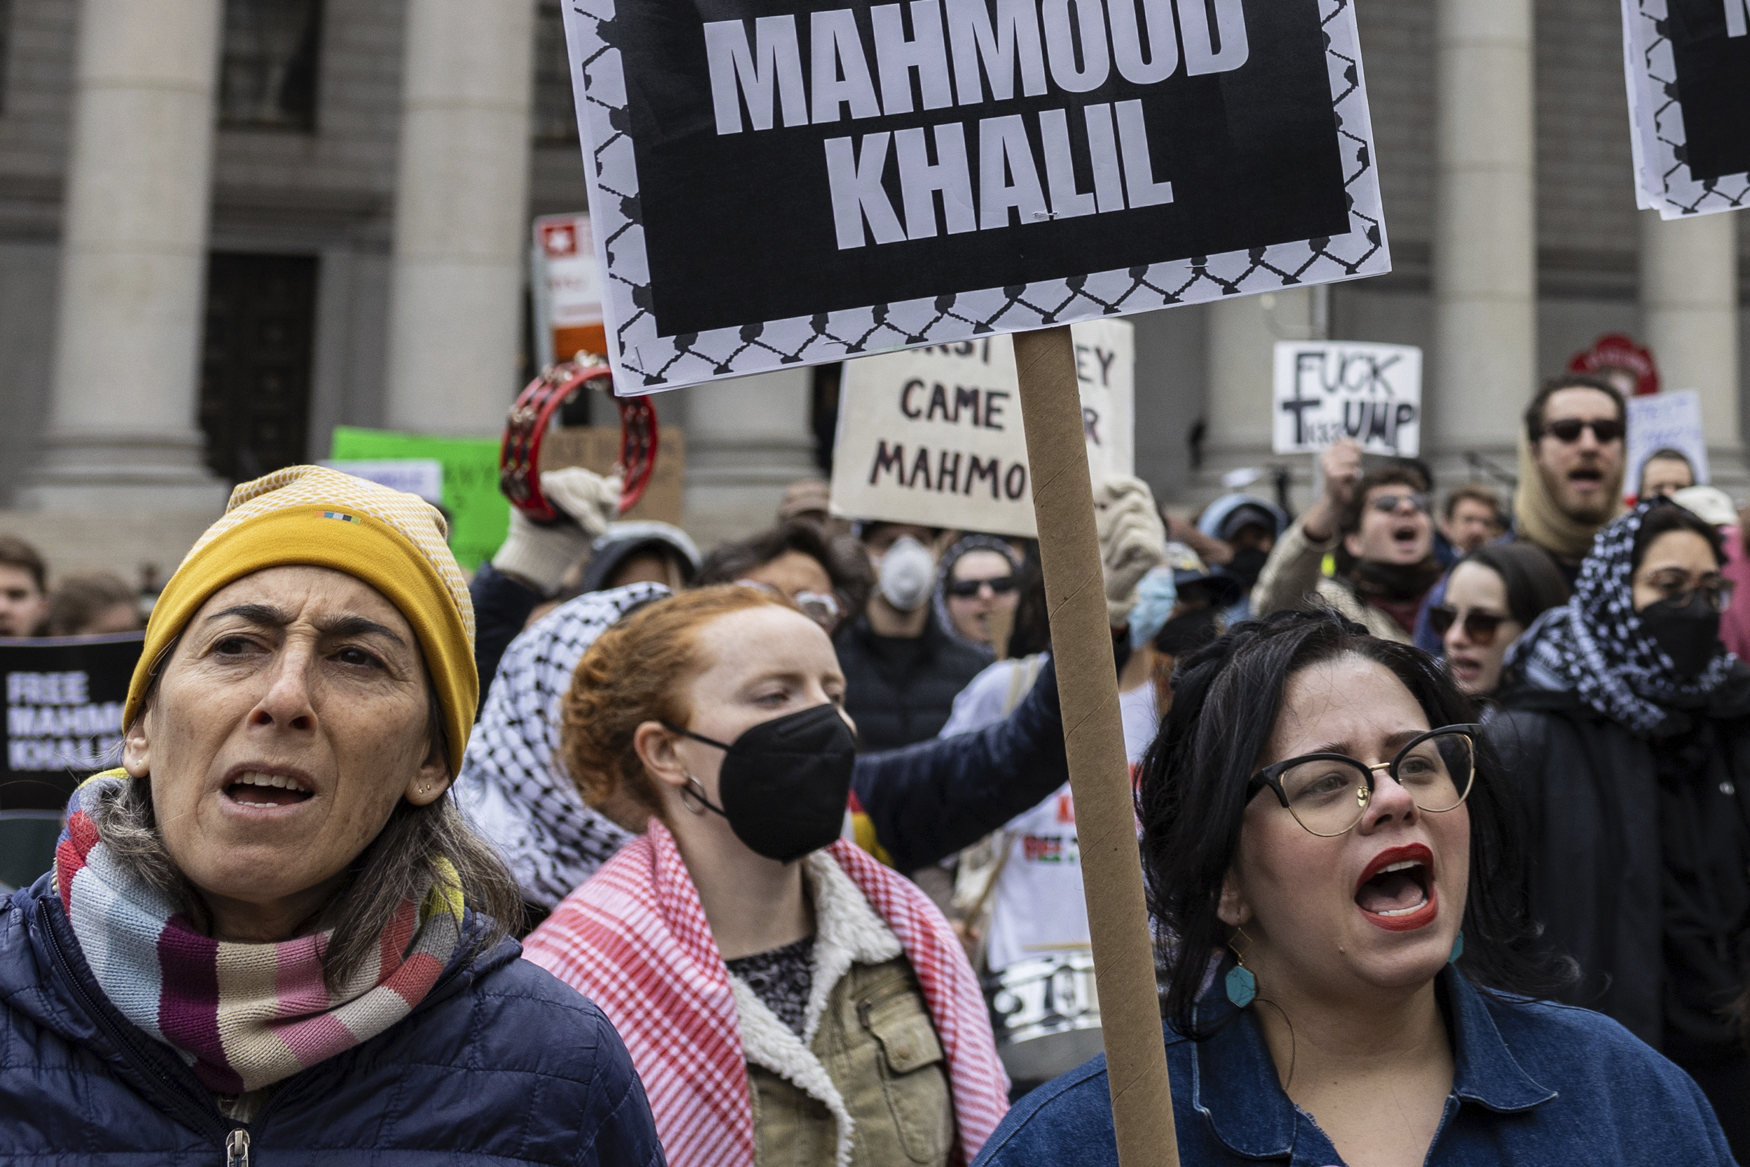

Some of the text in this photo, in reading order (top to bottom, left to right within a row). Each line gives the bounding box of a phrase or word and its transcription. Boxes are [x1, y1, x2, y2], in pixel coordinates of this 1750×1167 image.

[823, 99, 1174, 250] KHALIL
[1294, 351, 1403, 398] FUCK
[899, 378, 1011, 432] CAME
[868, 437, 1027, 502] MAHMO
[6, 670, 90, 704] FREE
